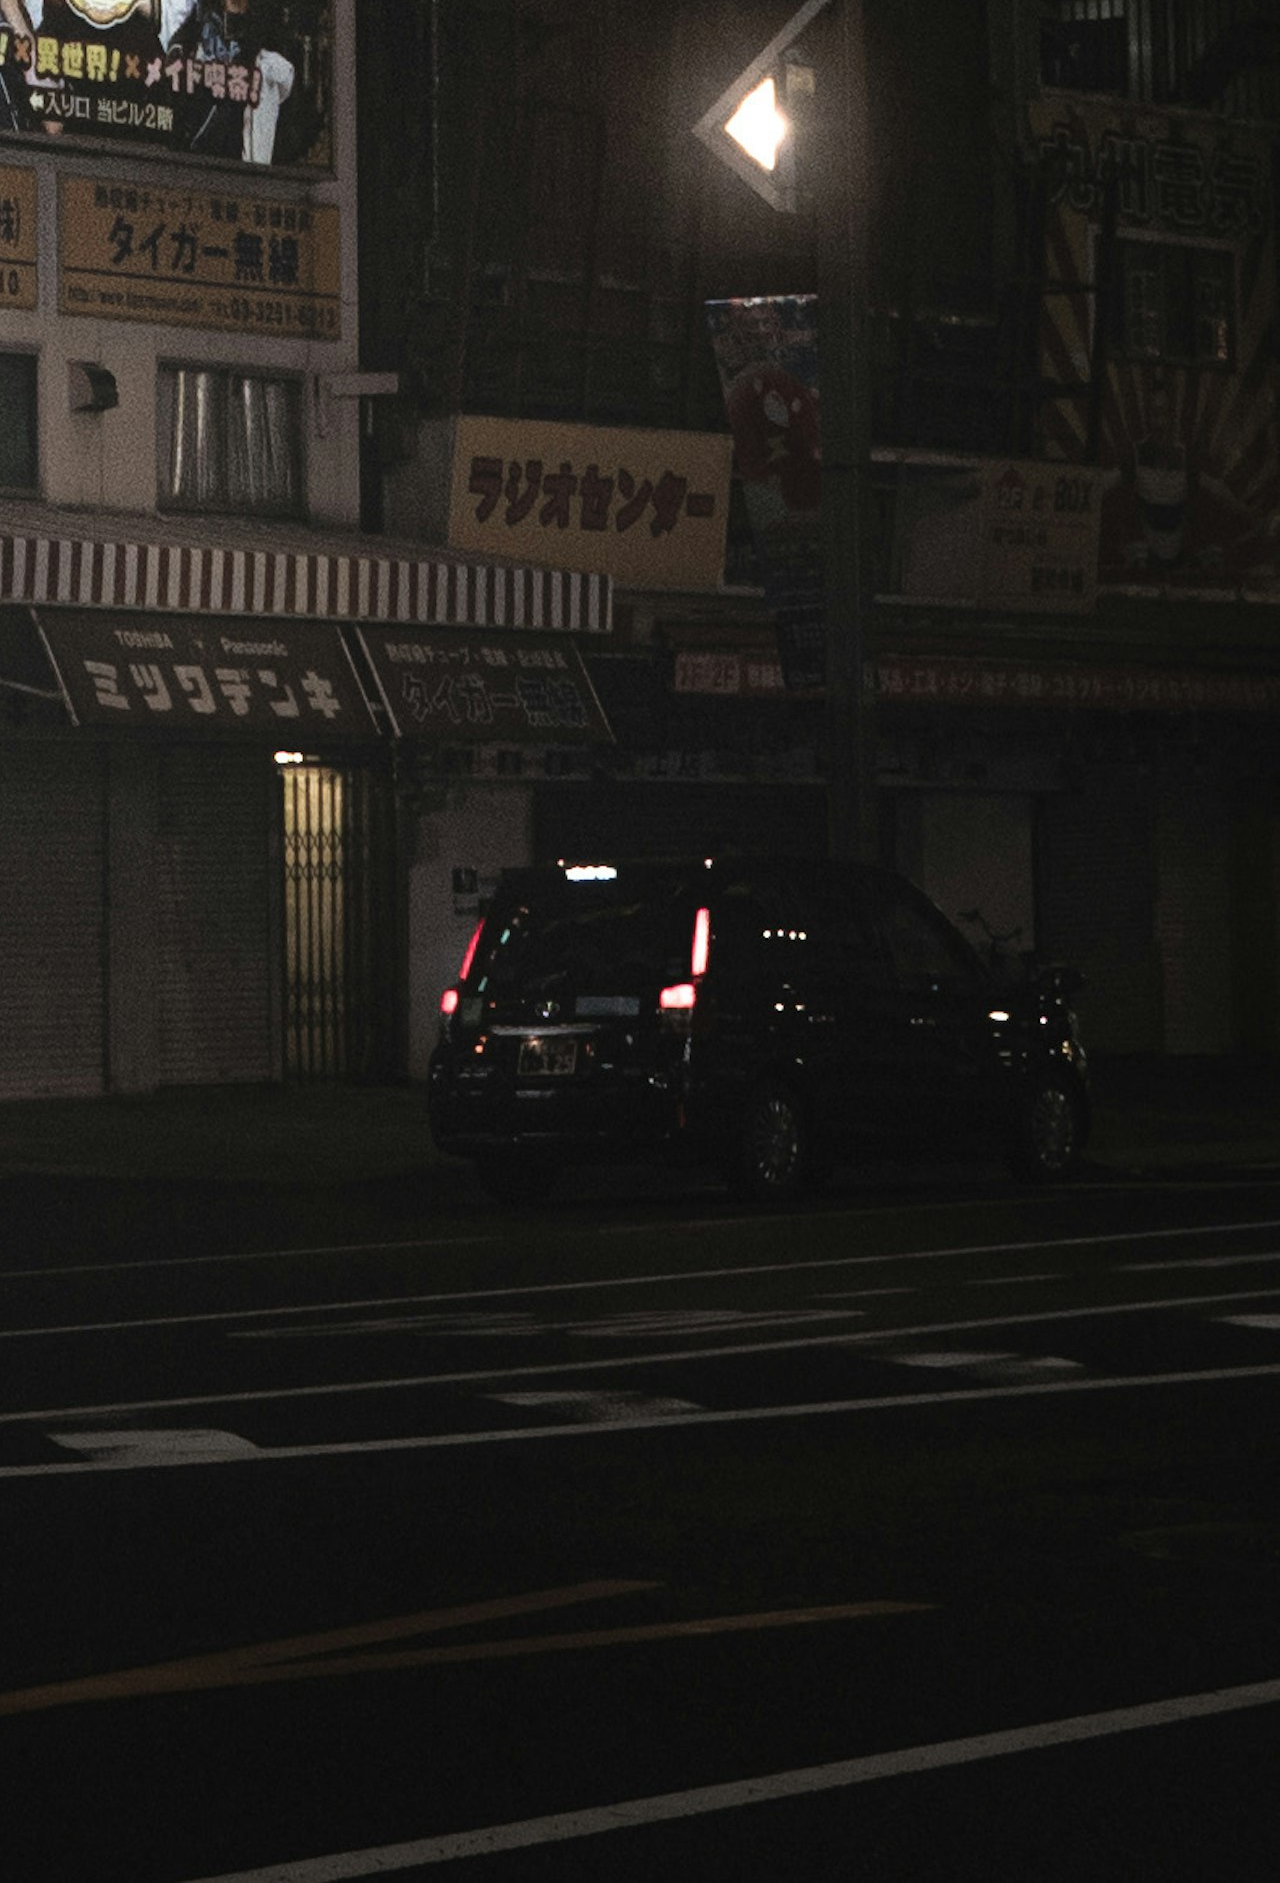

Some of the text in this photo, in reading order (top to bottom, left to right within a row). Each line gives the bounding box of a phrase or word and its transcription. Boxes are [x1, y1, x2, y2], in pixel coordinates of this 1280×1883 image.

[35, 36, 122, 82] 異世界!
[145, 58, 262, 109] メイド喫茶!
[107, 215, 300, 284] タイガー無線
[468, 456, 716, 538] ラジオセンター
[113, 628, 290, 658] TOSHIBA Panasonic
[83, 659, 342, 720] ミツワデンキ
